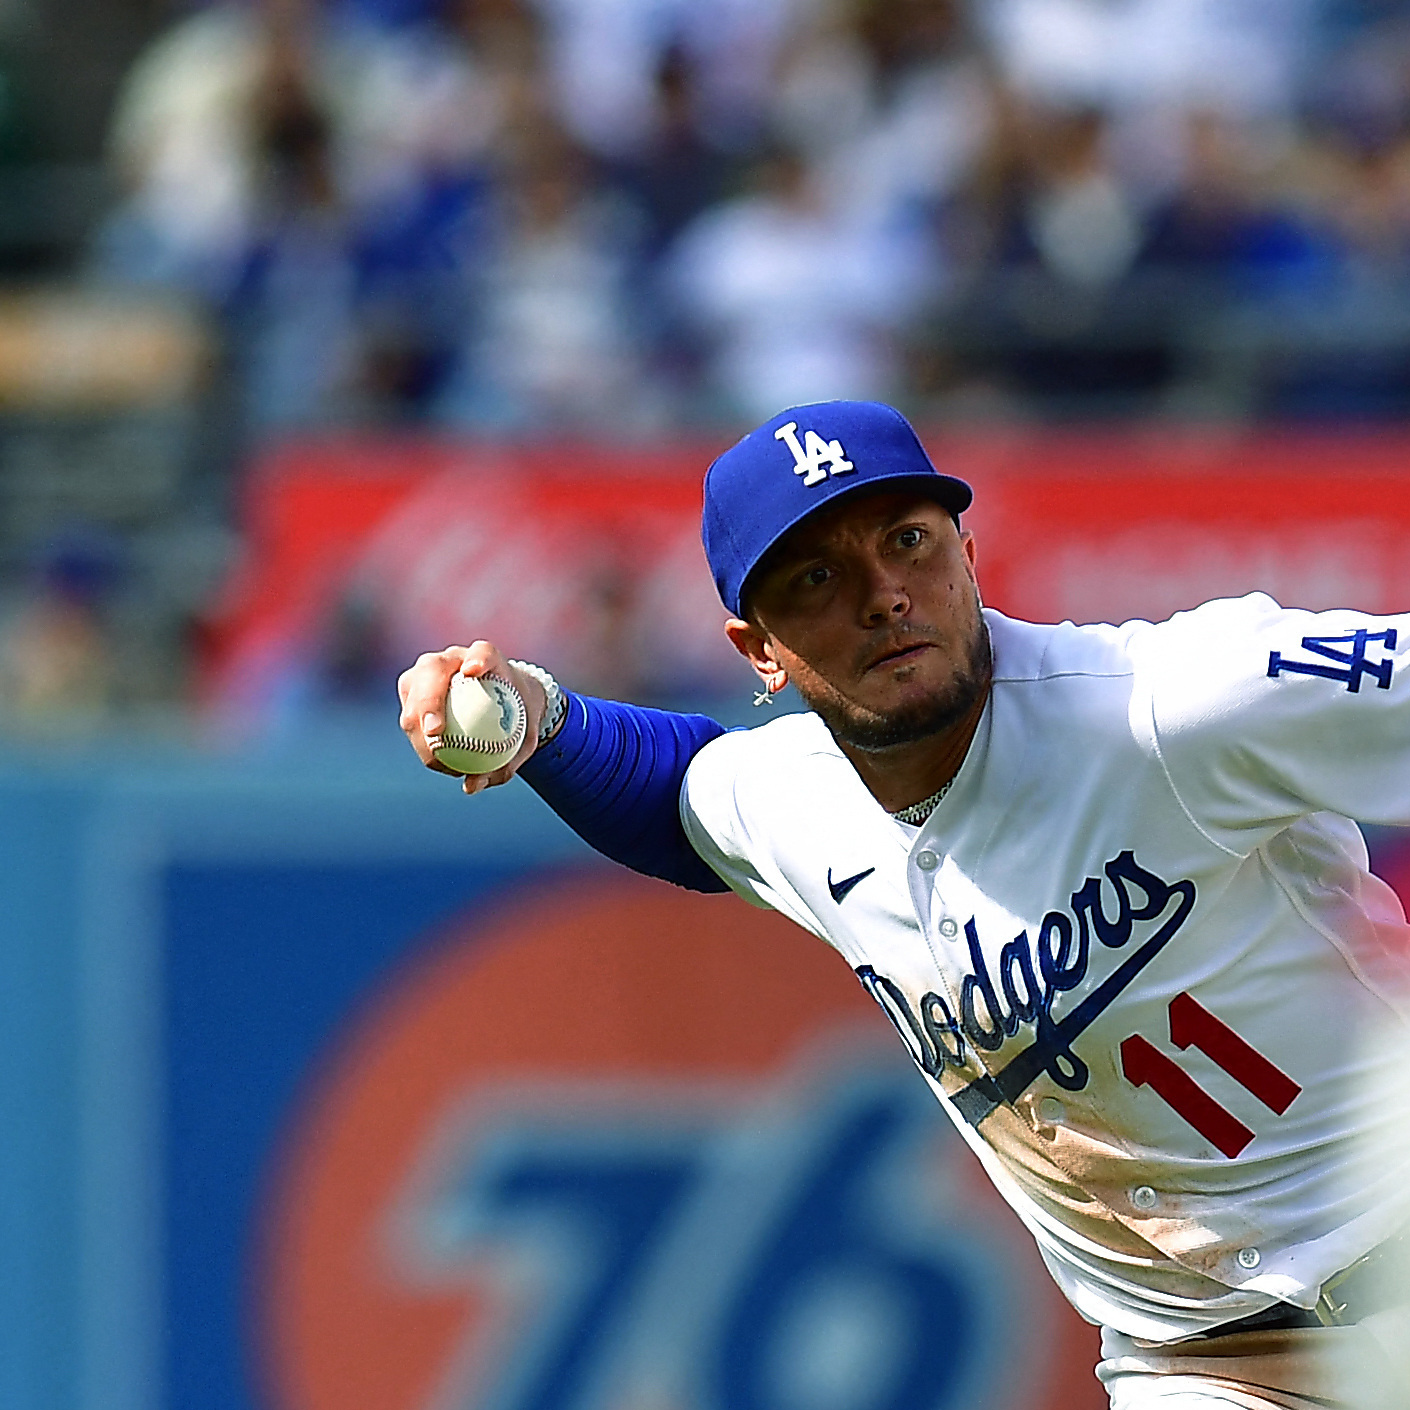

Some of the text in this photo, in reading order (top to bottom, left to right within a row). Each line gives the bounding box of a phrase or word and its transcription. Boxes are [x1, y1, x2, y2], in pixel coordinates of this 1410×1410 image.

[773, 421, 855, 487] LA
[1266, 628, 1398, 693] LA
[1120, 991, 1304, 1160] 11
